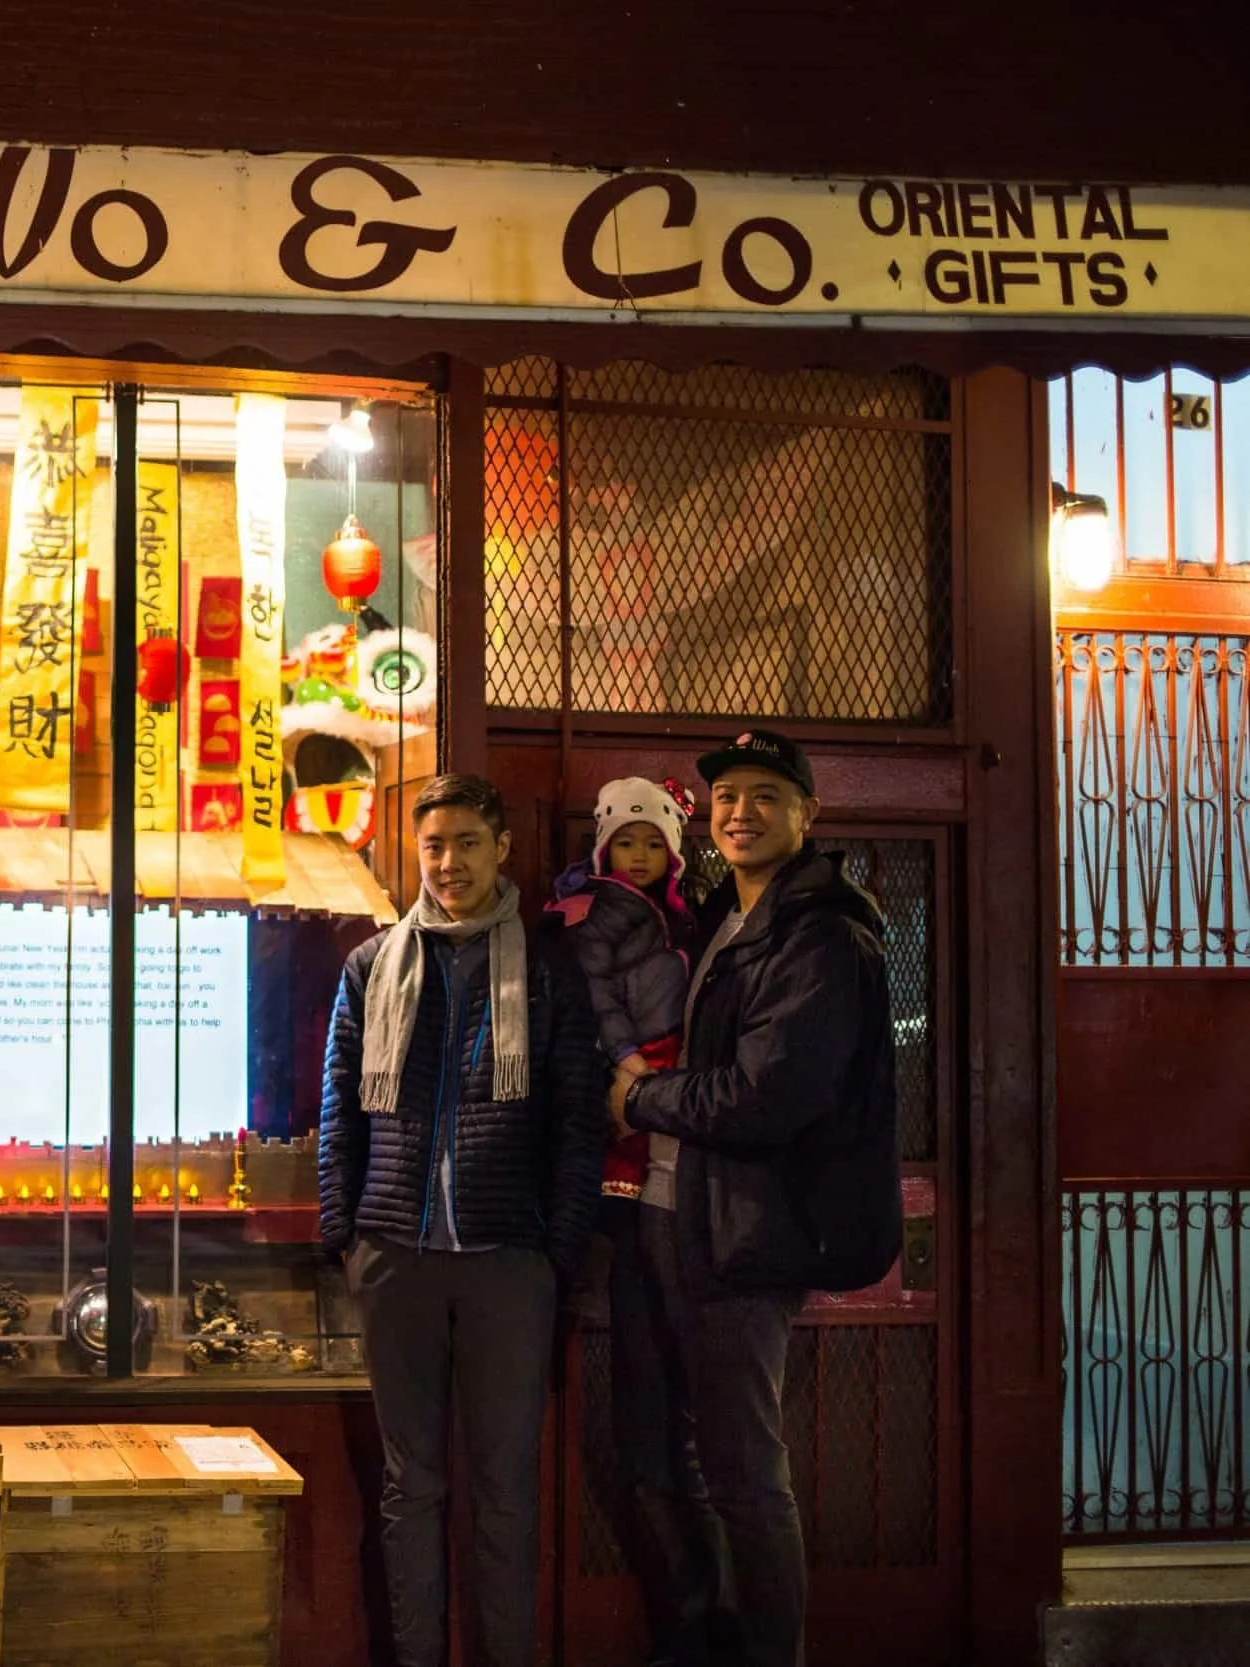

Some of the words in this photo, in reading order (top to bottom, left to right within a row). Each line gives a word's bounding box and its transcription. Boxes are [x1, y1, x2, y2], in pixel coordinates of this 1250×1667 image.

[278, 154, 457, 291] &
[562, 172, 838, 305] Co.
[859, 179, 1169, 240] ORIENTAL
[925, 249, 1128, 306] GIFTS
[1171, 396, 1210, 428] 26
[4, 419, 87, 760] 恭喜發財
[22, 943, 44, 953] New
[200, 945, 222, 955] work
[13, 998, 27, 1008] My
[188, 1000, 200, 1009] off
[201, 1018, 221, 1029] help
